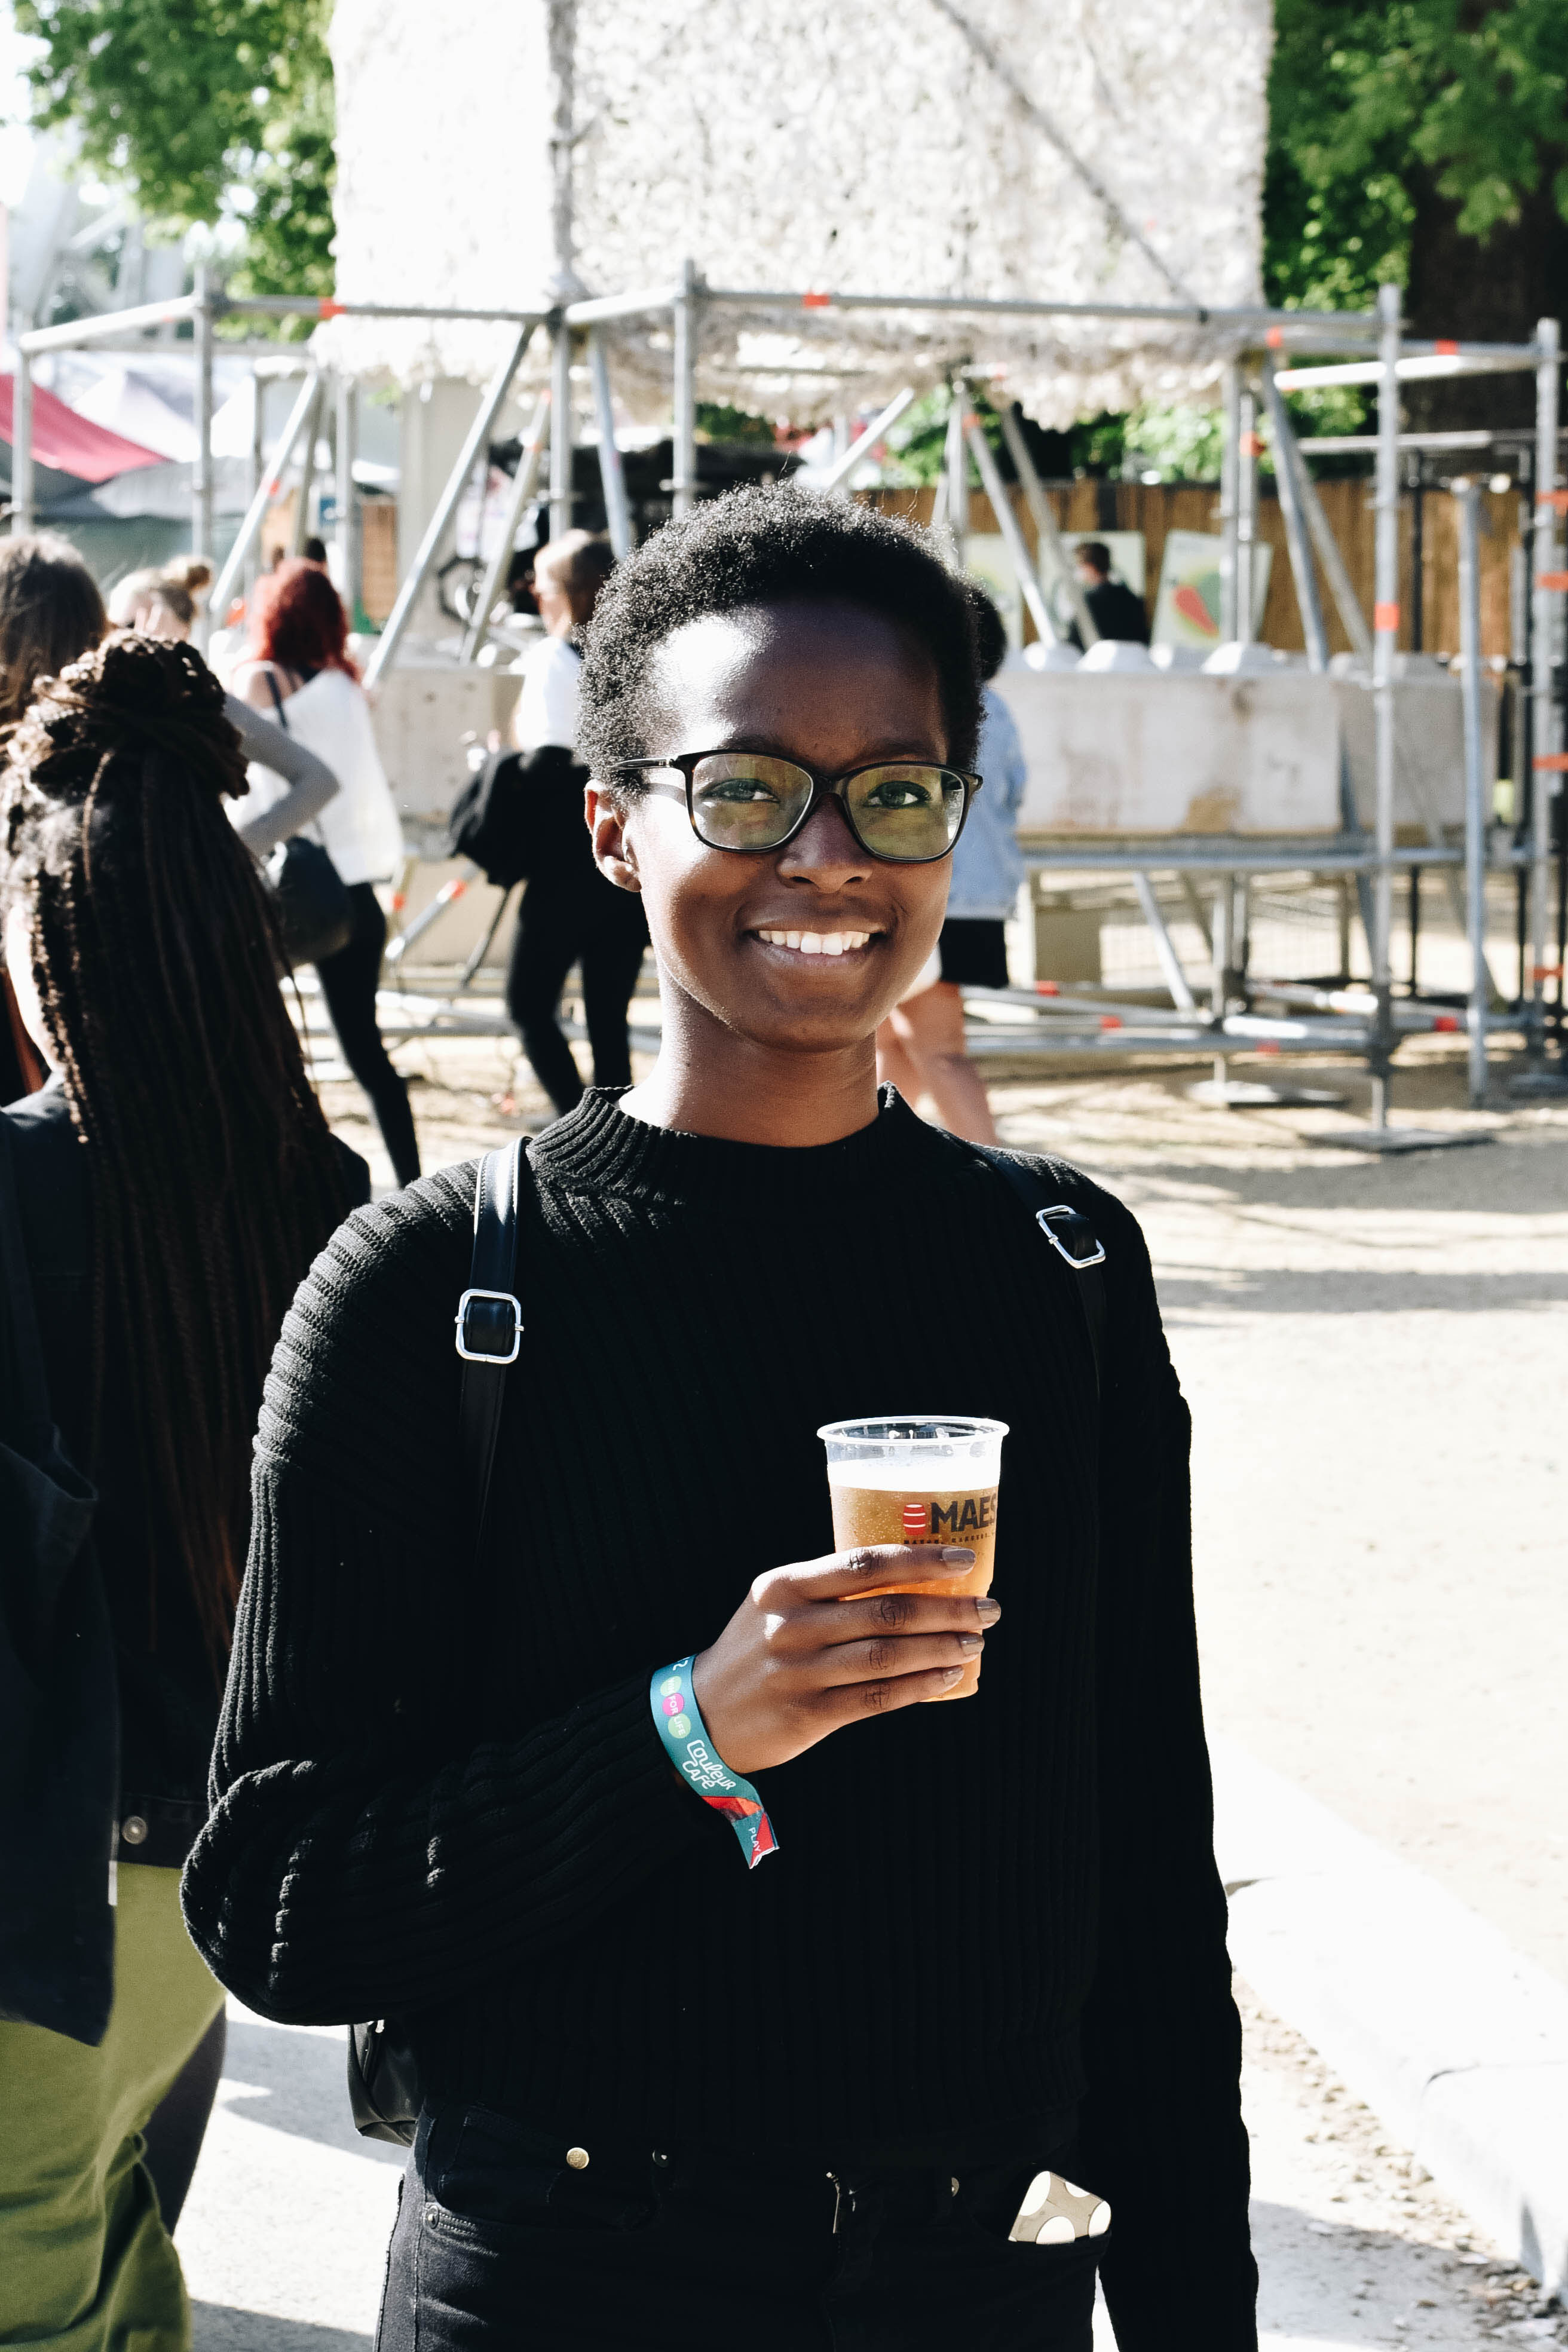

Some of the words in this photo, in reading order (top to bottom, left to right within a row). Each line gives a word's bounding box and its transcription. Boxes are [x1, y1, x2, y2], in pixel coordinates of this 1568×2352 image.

[669, 1695, 678, 1714] FOR
[674, 1715, 686, 1735] LIFE
[748, 1827, 761, 1851] PLAY
